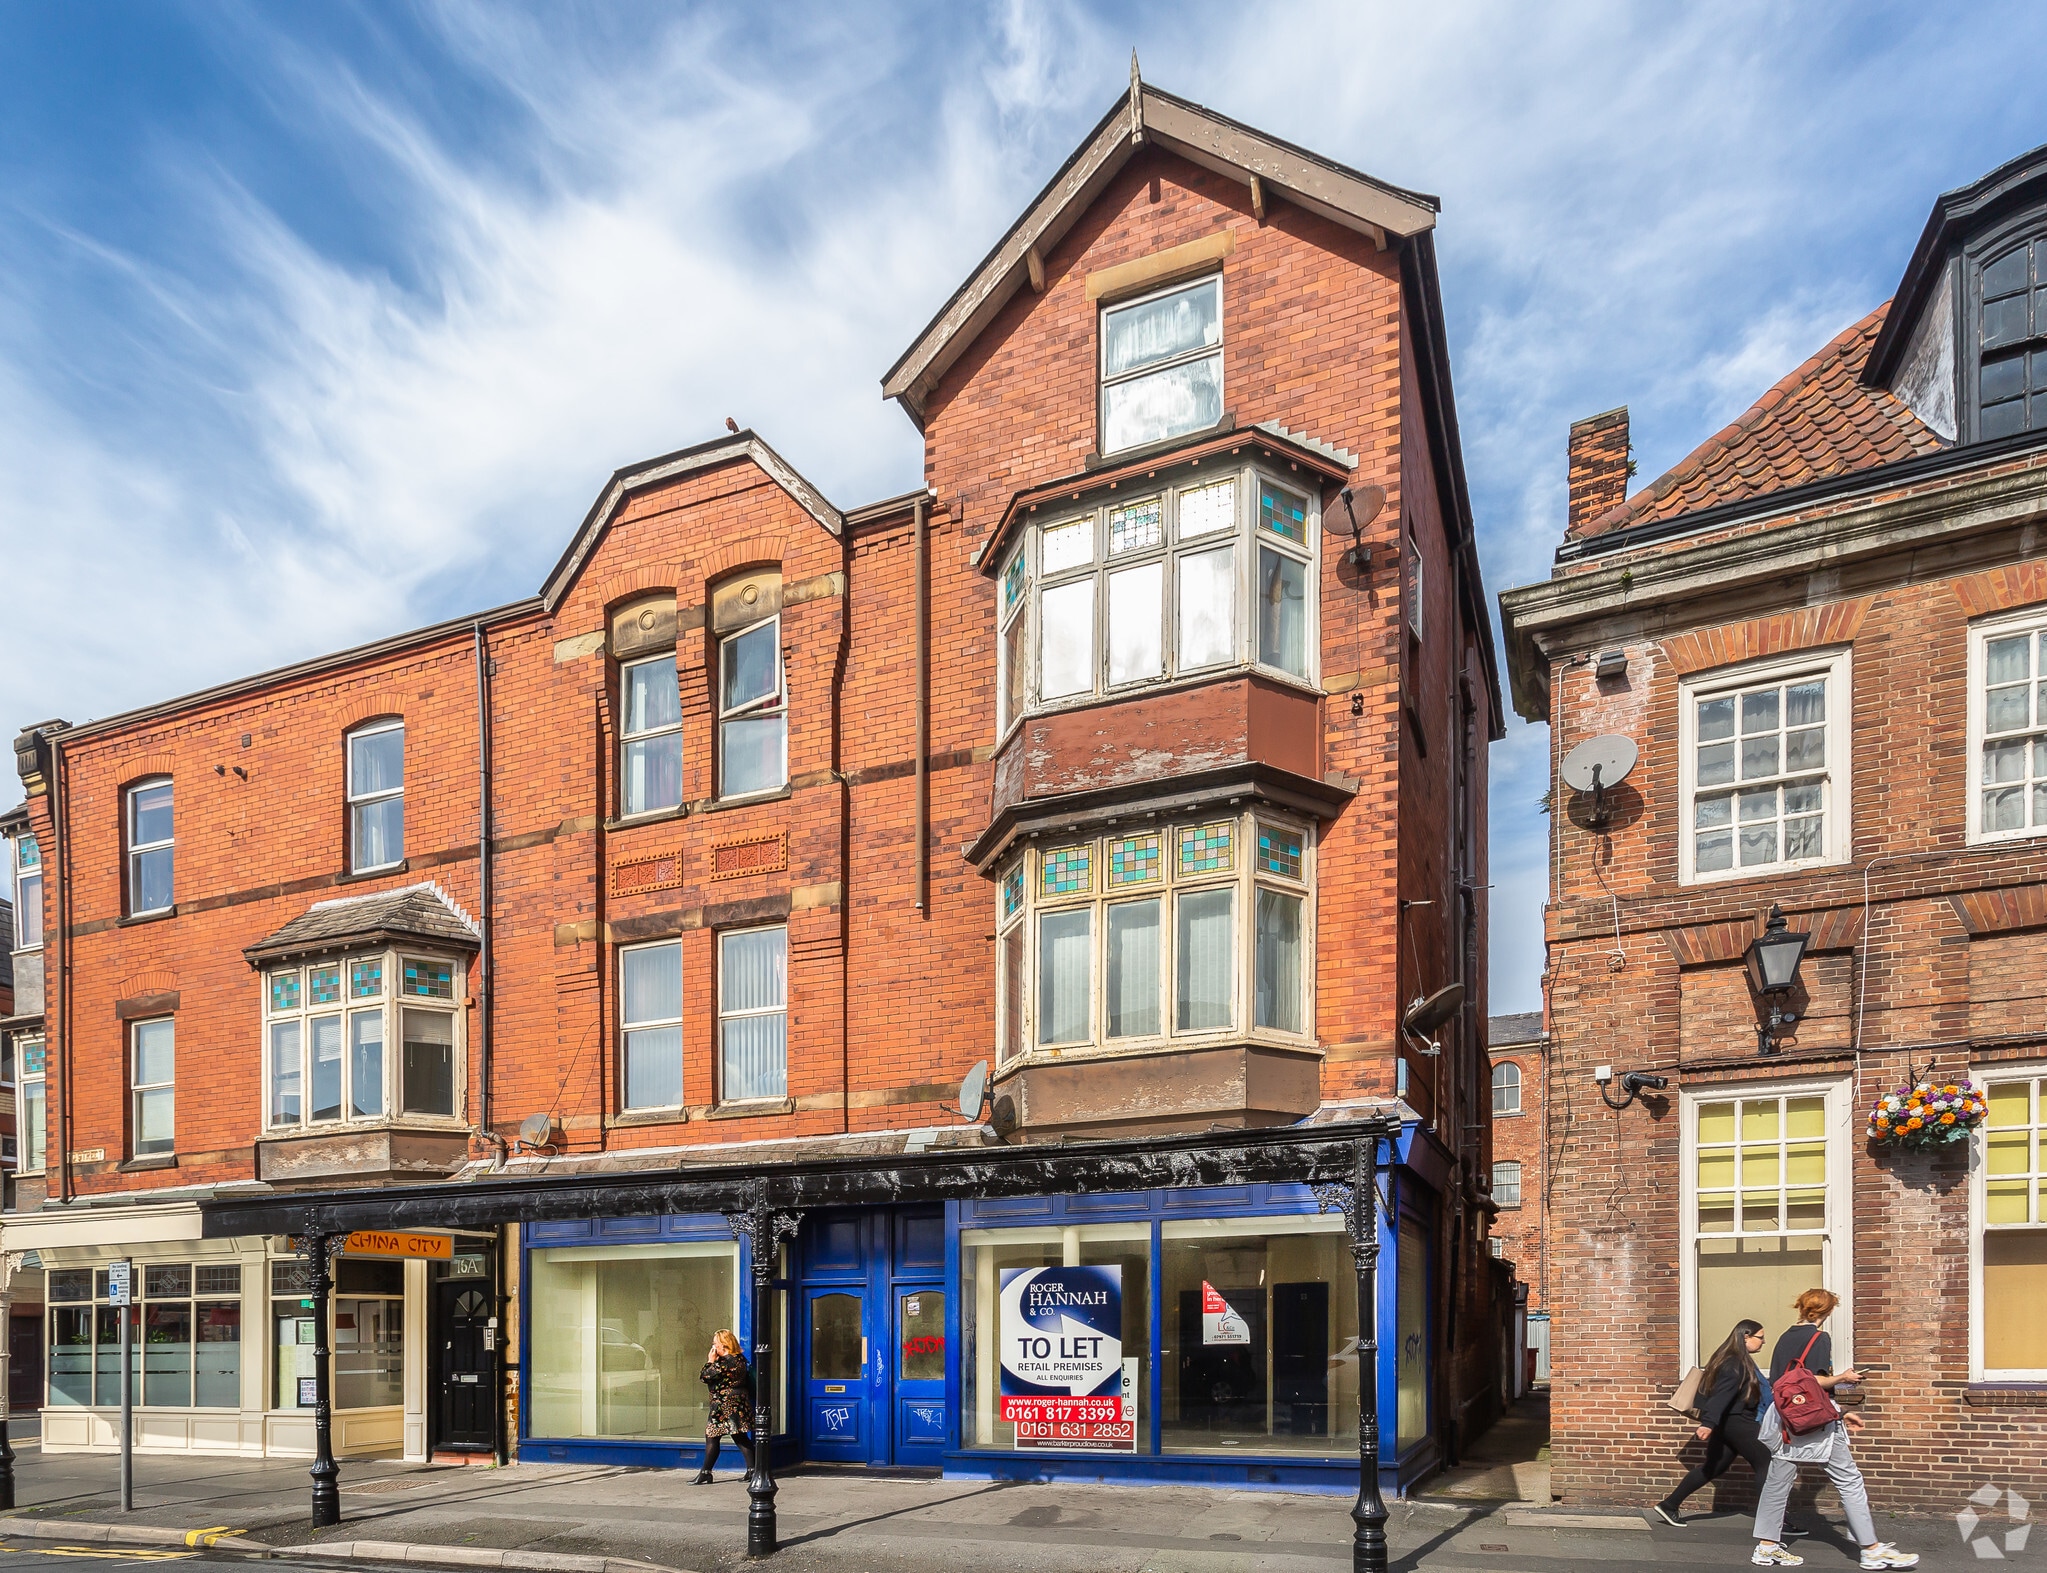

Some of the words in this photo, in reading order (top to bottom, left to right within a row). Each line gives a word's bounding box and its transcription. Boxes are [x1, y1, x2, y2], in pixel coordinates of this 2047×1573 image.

[350, 1233, 399, 1250] CHINA
[408, 1238, 442, 1253] CITY
[457, 1258, 480, 1274] 16A
[1029, 1283, 1064, 1292] ROGER
[1029, 1291, 1107, 1306] HANNAH
[1029, 1307, 1037, 1316] &
[1040, 1307, 1055, 1316] CO.
[1018, 1337, 1051, 1359] TO
[1060, 1337, 1103, 1359] LET
[1018, 1362, 1050, 1371] RETAIL
[1053, 1362, 1103, 1371] PREMISES
[1050, 1374, 1084, 1382] ENQUIRIES
[1008, 1398, 1114, 1408] www.roger-hannah.co.uk
[1006, 1407, 1039, 1419] 0161
[1046, 1407, 1072, 1420] 817
[1078, 1407, 1116, 1420] 3399
[1020, 1421, 1054, 1436] 0161
[1060, 1422, 1087, 1436] 631
[1093, 1422, 1131, 1438] 2852
